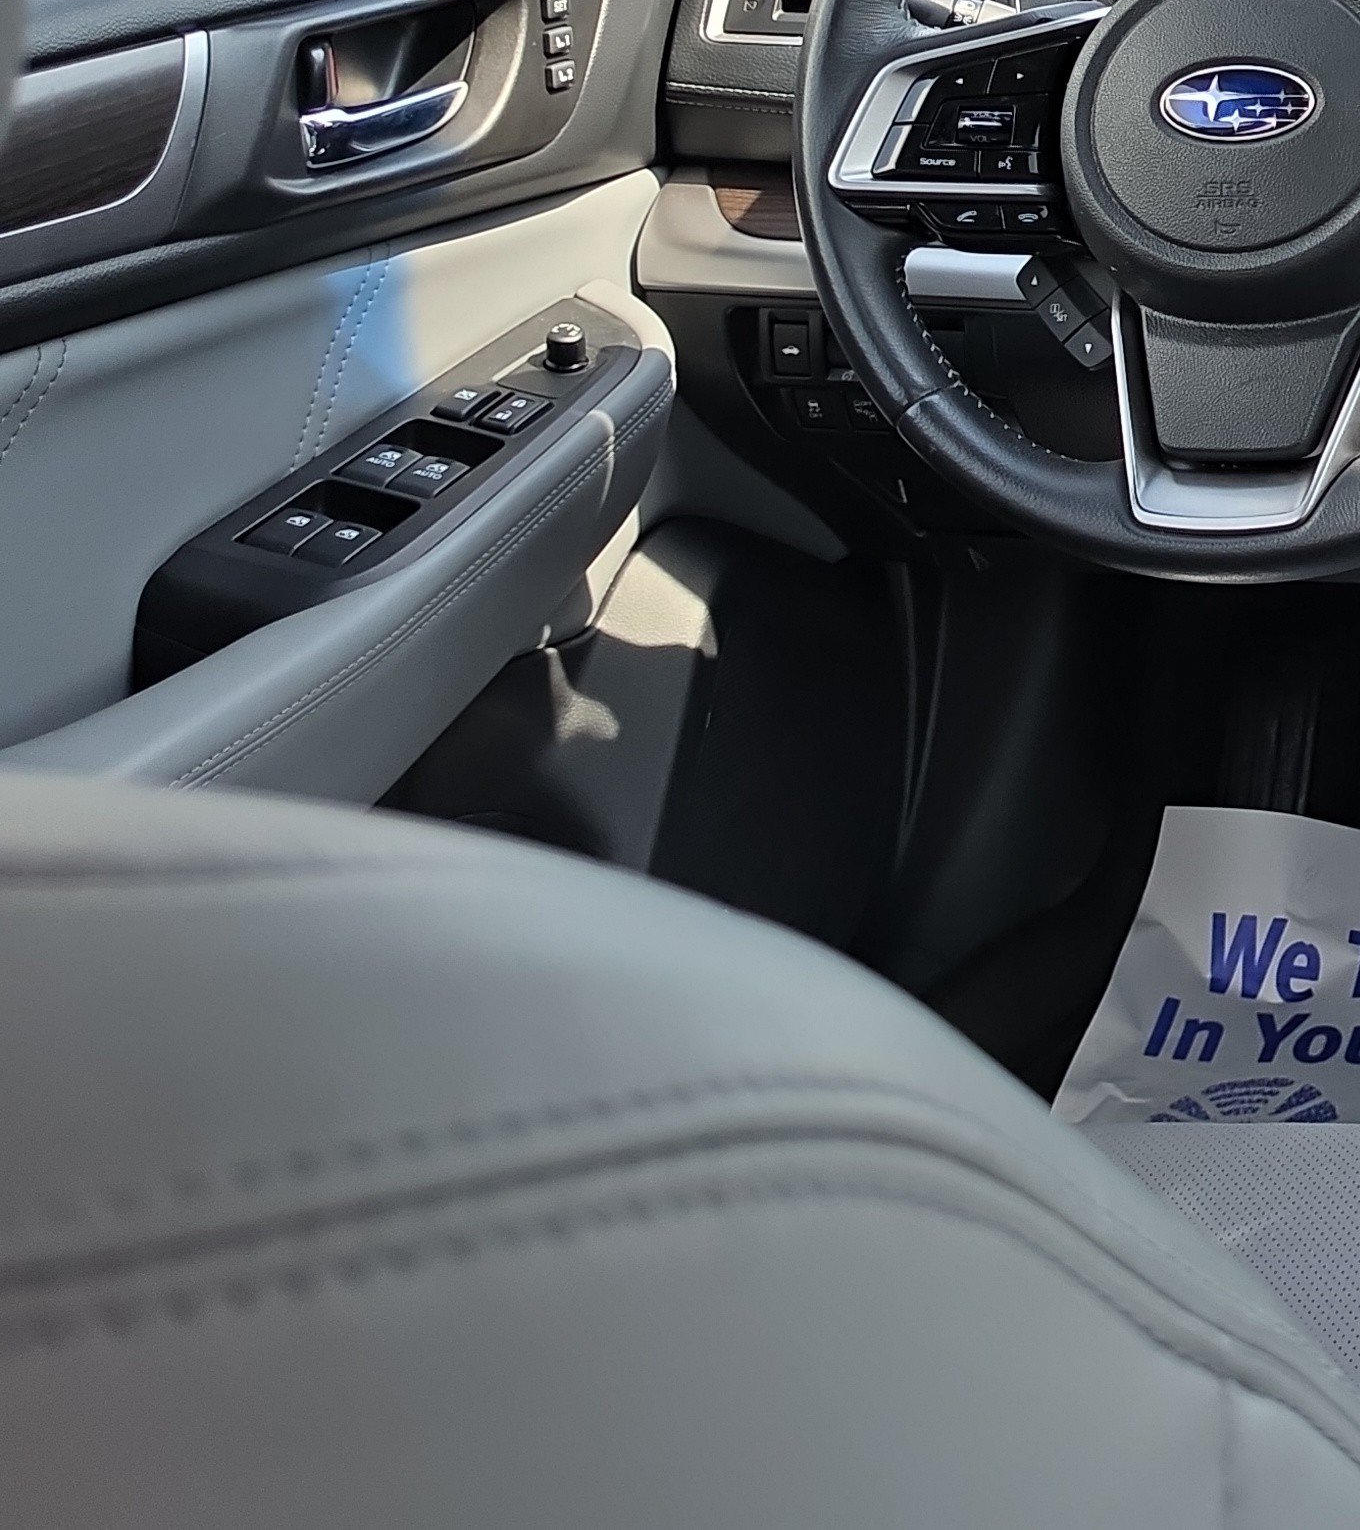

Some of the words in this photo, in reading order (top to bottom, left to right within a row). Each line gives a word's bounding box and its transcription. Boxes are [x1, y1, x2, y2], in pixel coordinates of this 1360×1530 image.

[553, 0, 568, 12] SET
[919, 157, 956, 167] Source
[1204, 181, 1254, 195] SRS
[1195, 197, 1263, 208] AIRBAG
[366, 456, 396, 468] AUTO
[412, 469, 443, 480] AUTO
[1206, 911, 1322, 1004] We
[1144, 997, 1225, 1062] In
